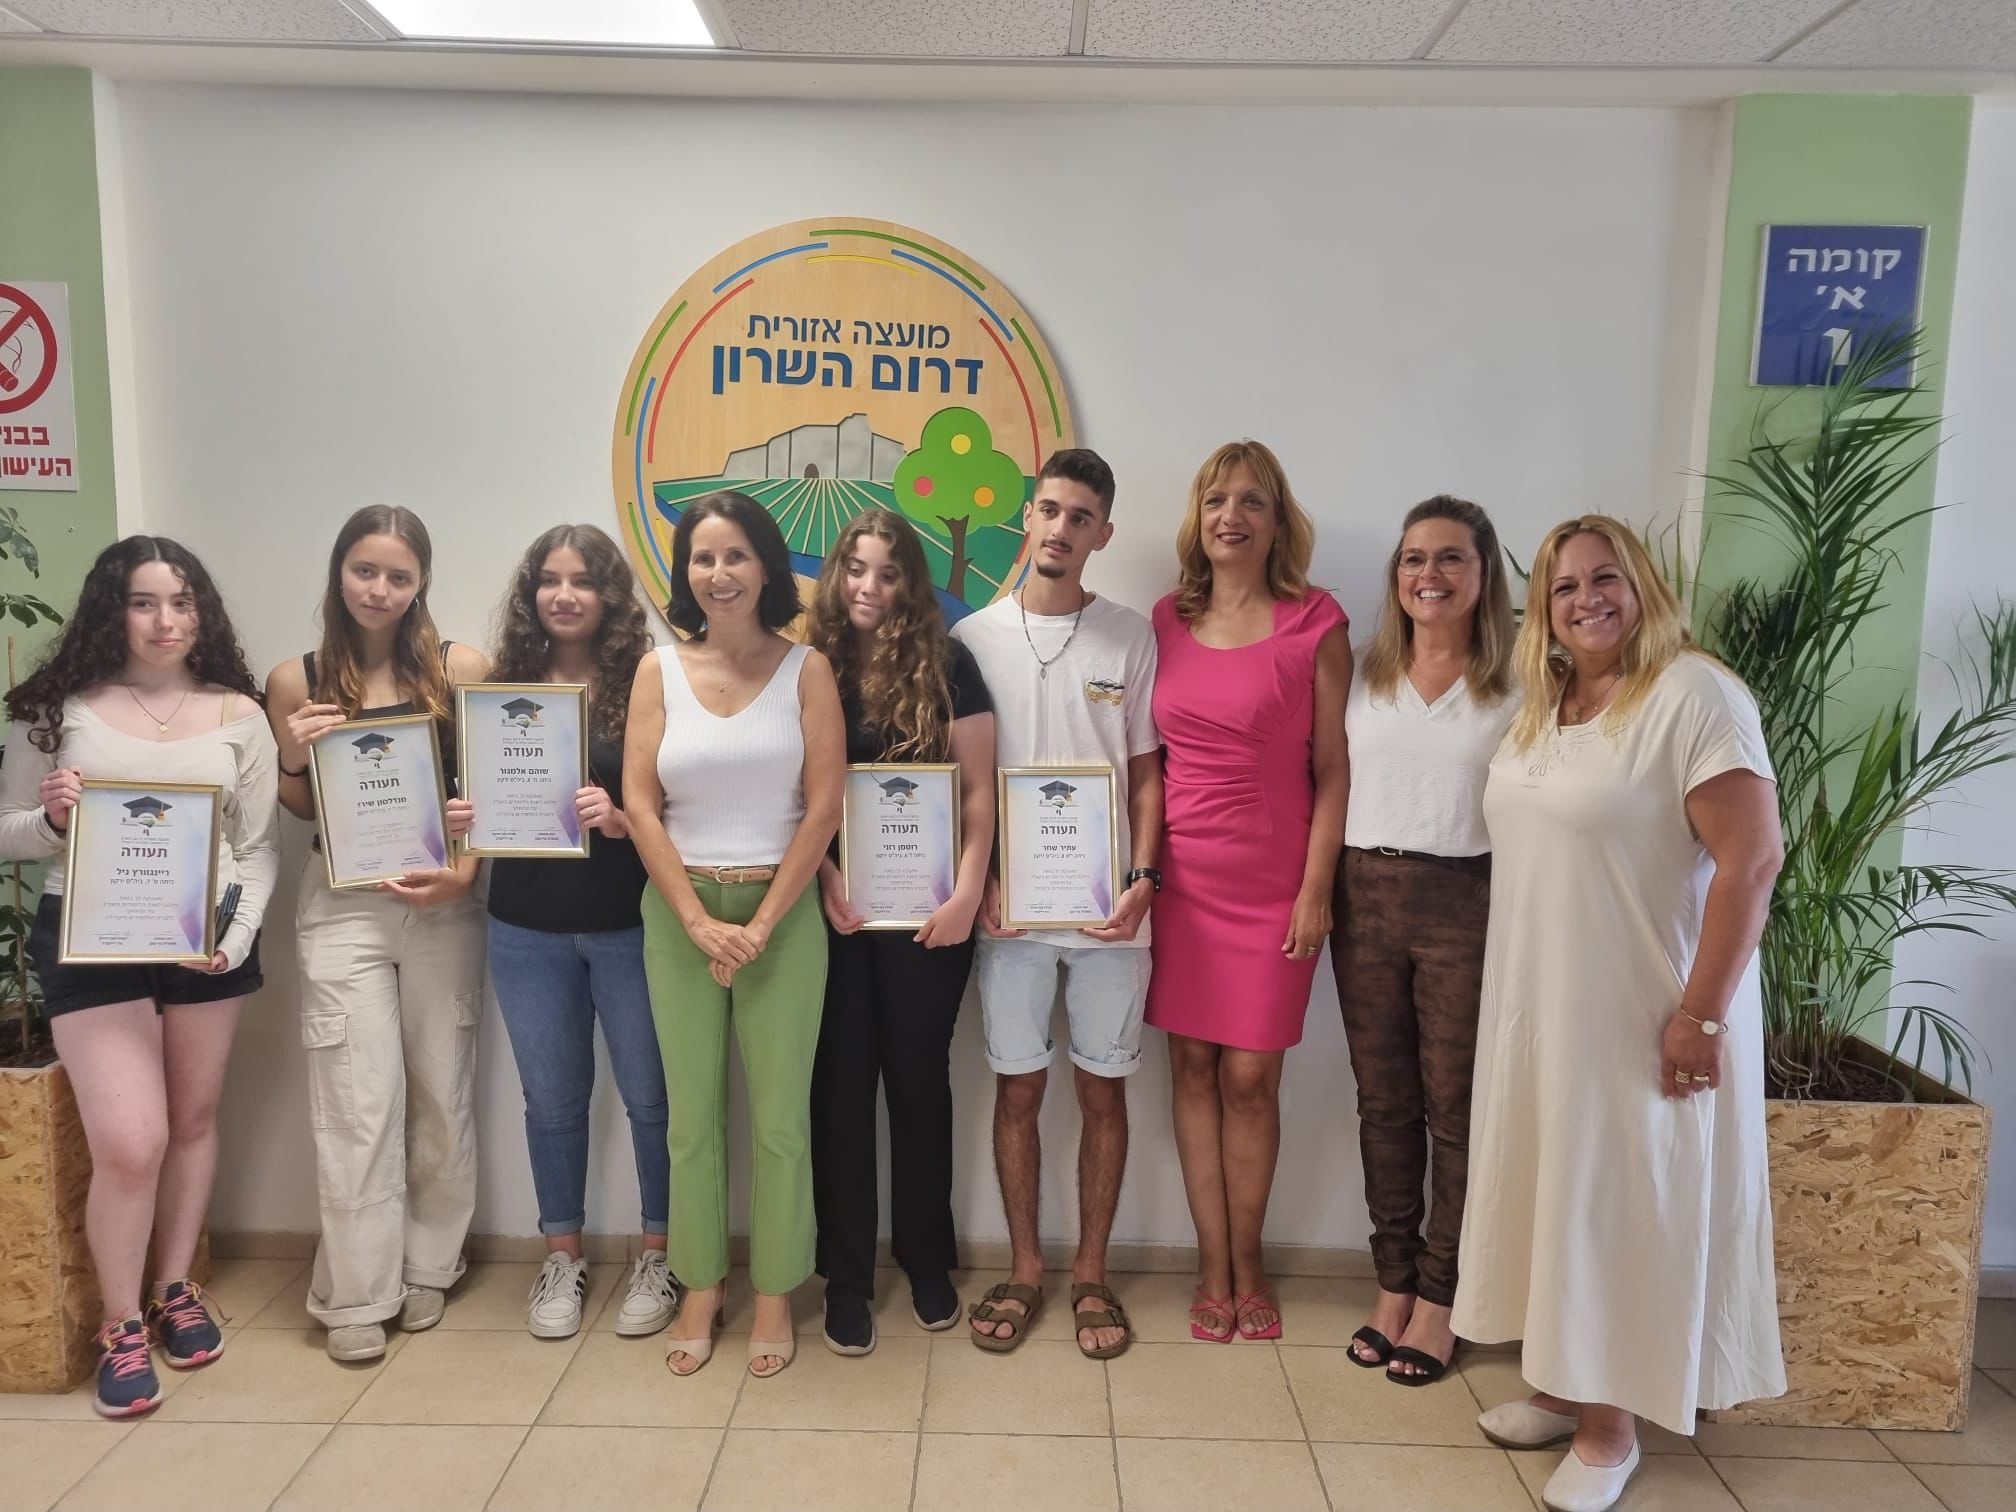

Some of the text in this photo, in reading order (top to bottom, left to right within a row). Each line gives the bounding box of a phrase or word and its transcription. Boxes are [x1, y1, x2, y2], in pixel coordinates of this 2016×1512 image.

[1787, 248, 1902, 279] קומה
[747, 314, 951, 349] מועצה אזורית
[712, 345, 984, 395] דרום השרון
[503, 747, 544, 757] תעודה
[359, 778, 400, 791] תעודה
[377, 797, 407, 807] מנדלסון
[881, 824, 919, 834] תעודה
[1041, 825, 1077, 835] תעודה
[121, 846, 168, 858] תעודה
